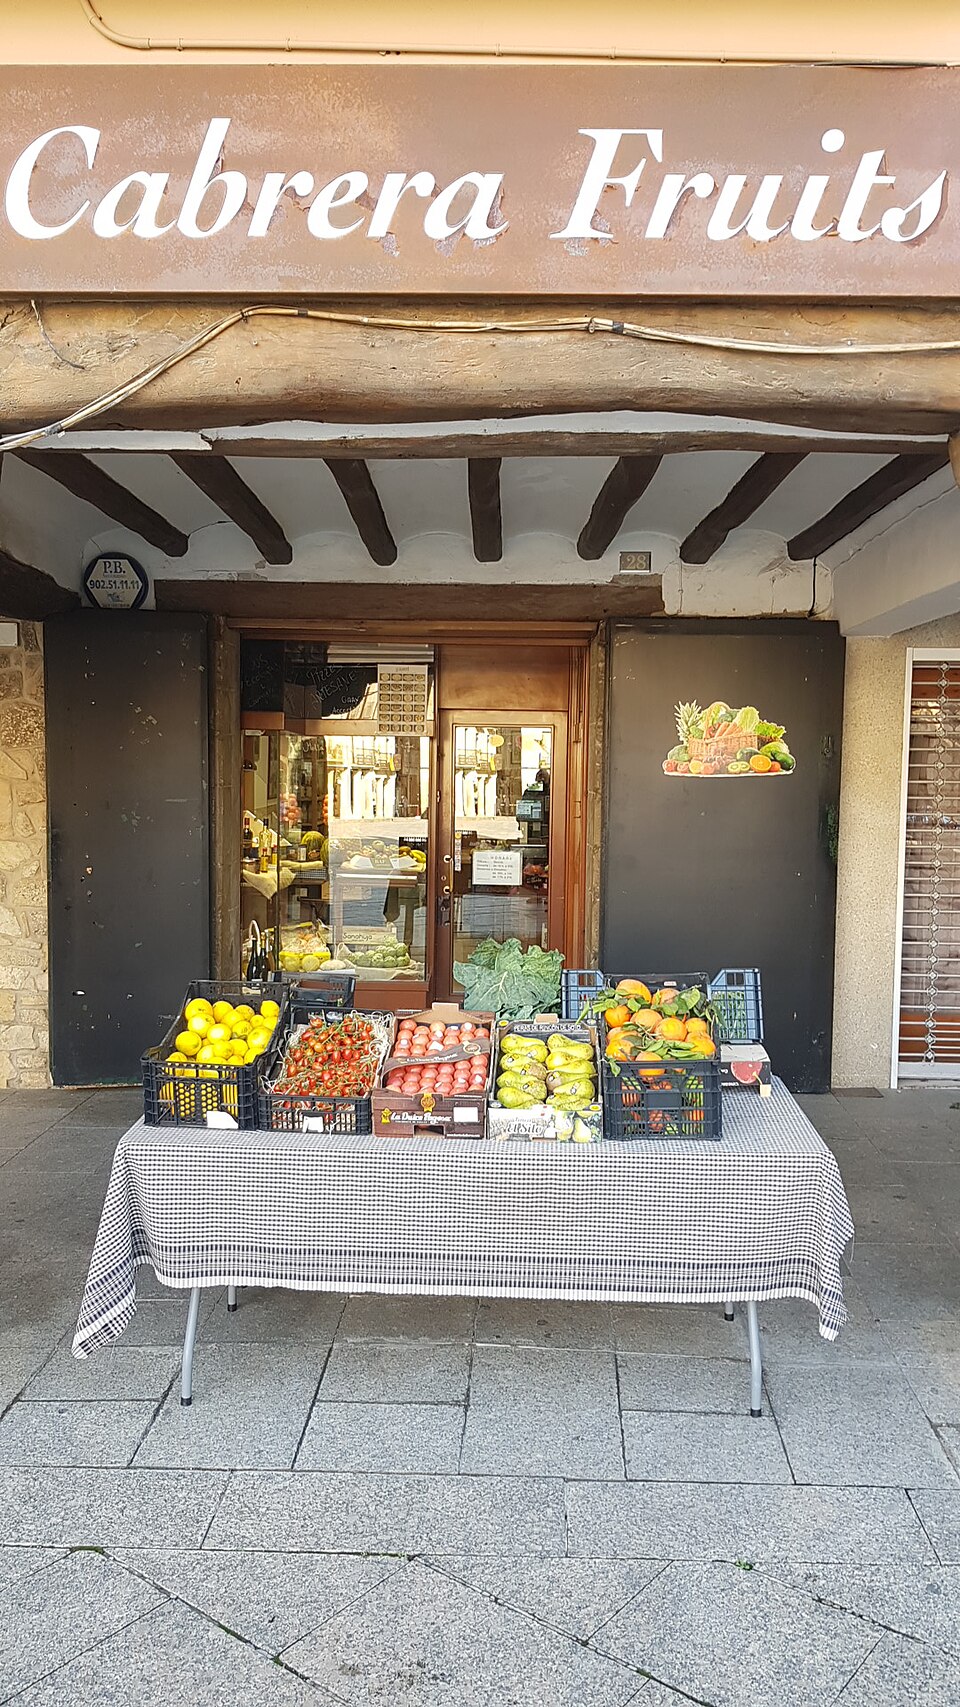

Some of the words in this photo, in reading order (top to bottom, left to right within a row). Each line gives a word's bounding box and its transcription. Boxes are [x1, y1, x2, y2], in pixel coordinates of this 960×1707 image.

[4, 116, 509, 240] Cabrera
[549, 127, 948, 243] Fruits
[102, 560, 126, 574] P.B.
[626, 554, 646, 570] 28
[89, 579, 140, 590] 902.51.11.11
